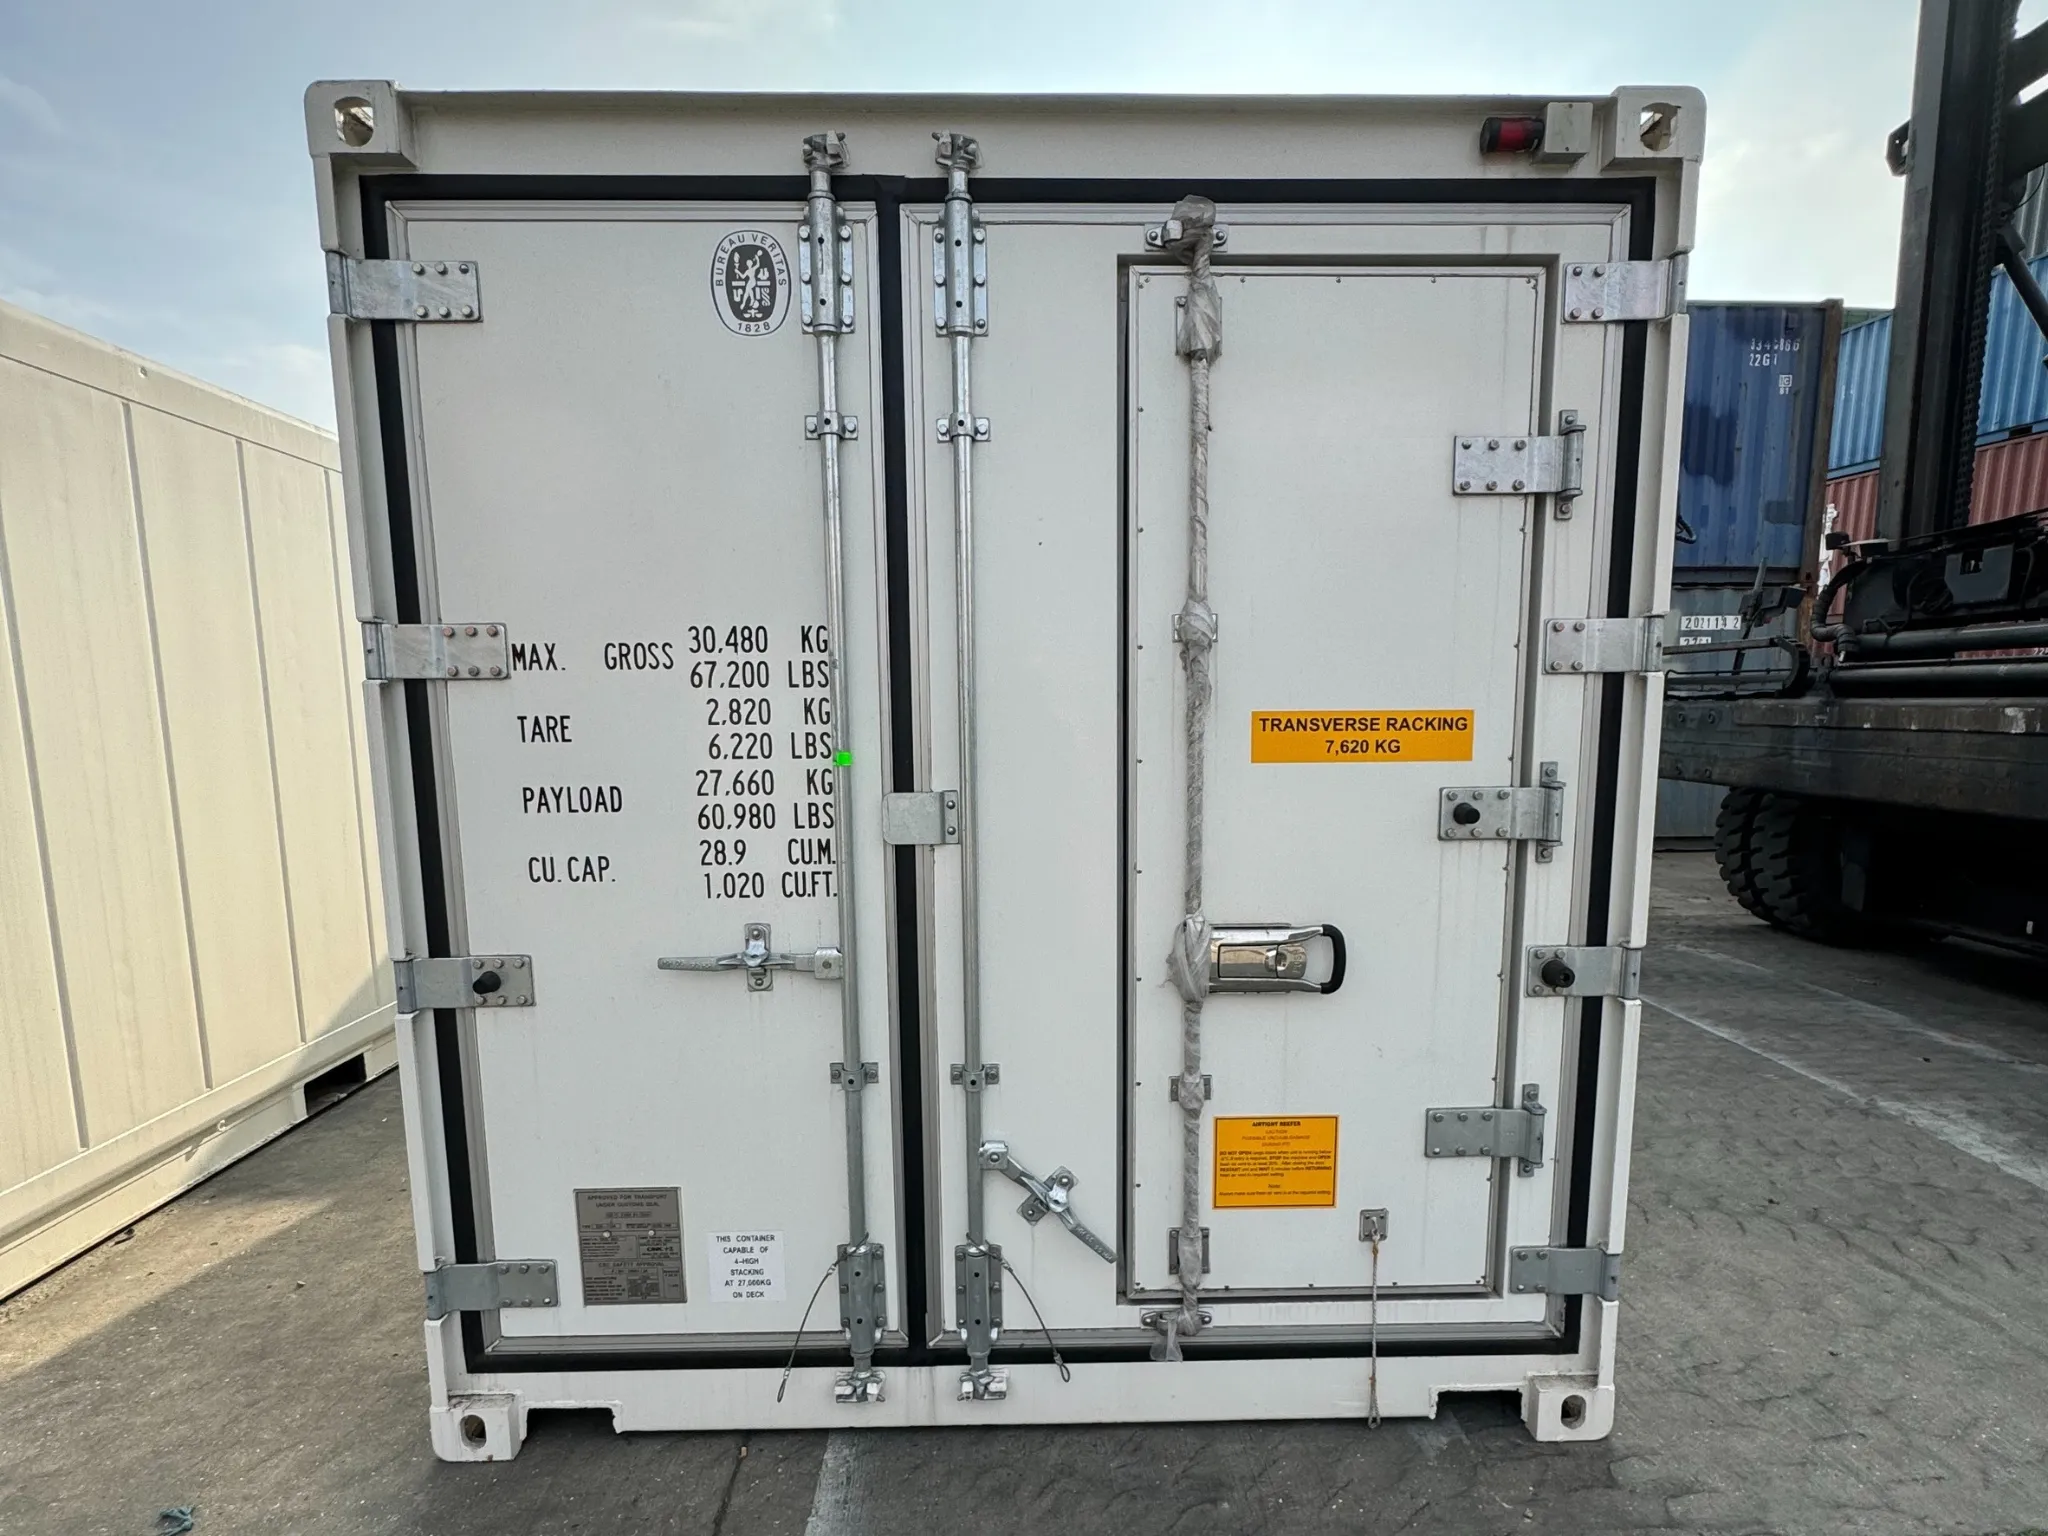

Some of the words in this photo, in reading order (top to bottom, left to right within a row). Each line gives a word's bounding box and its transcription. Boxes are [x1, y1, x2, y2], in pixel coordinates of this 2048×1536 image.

[715, 233, 745, 286] BUREAU
[751, 233, 787, 286] VERITAS
[738, 322, 770, 333] 1828
[688, 625, 768, 653] 30,480
[801, 625, 828, 653] KG
[512, 643, 566, 671] MAX.
[604, 642, 674, 670] GROSS
[690, 661, 770, 689] 67,200
[788, 660, 829, 688] LBS
[706, 698, 771, 726] 2,820
[804, 698, 831, 725] KG
[1259, 717, 1380, 732] TRANSVERSE
[1386, 717, 1468, 731] RACKING
[517, 716, 572, 743] TARE
[708, 732, 773, 760] 6,220
[791, 732, 832, 759] LBS
[1325, 740, 1369, 756] 7,620
[1375, 739, 1401, 753] KG
[695, 769, 774, 797] 27,660
[806, 769, 833, 796] KG
[522, 786, 623, 814] PAYLOAD
[698, 803, 776, 830] 60,980
[794, 803, 835, 829] LBS
[700, 840, 747, 866] 28.9
[703, 872, 764, 899] 1,020
[723, 1246, 754, 1254] CAPABLE
[736, 1234, 775, 1242] CONTAINER
[730, 1268, 764, 1276] STACKING
